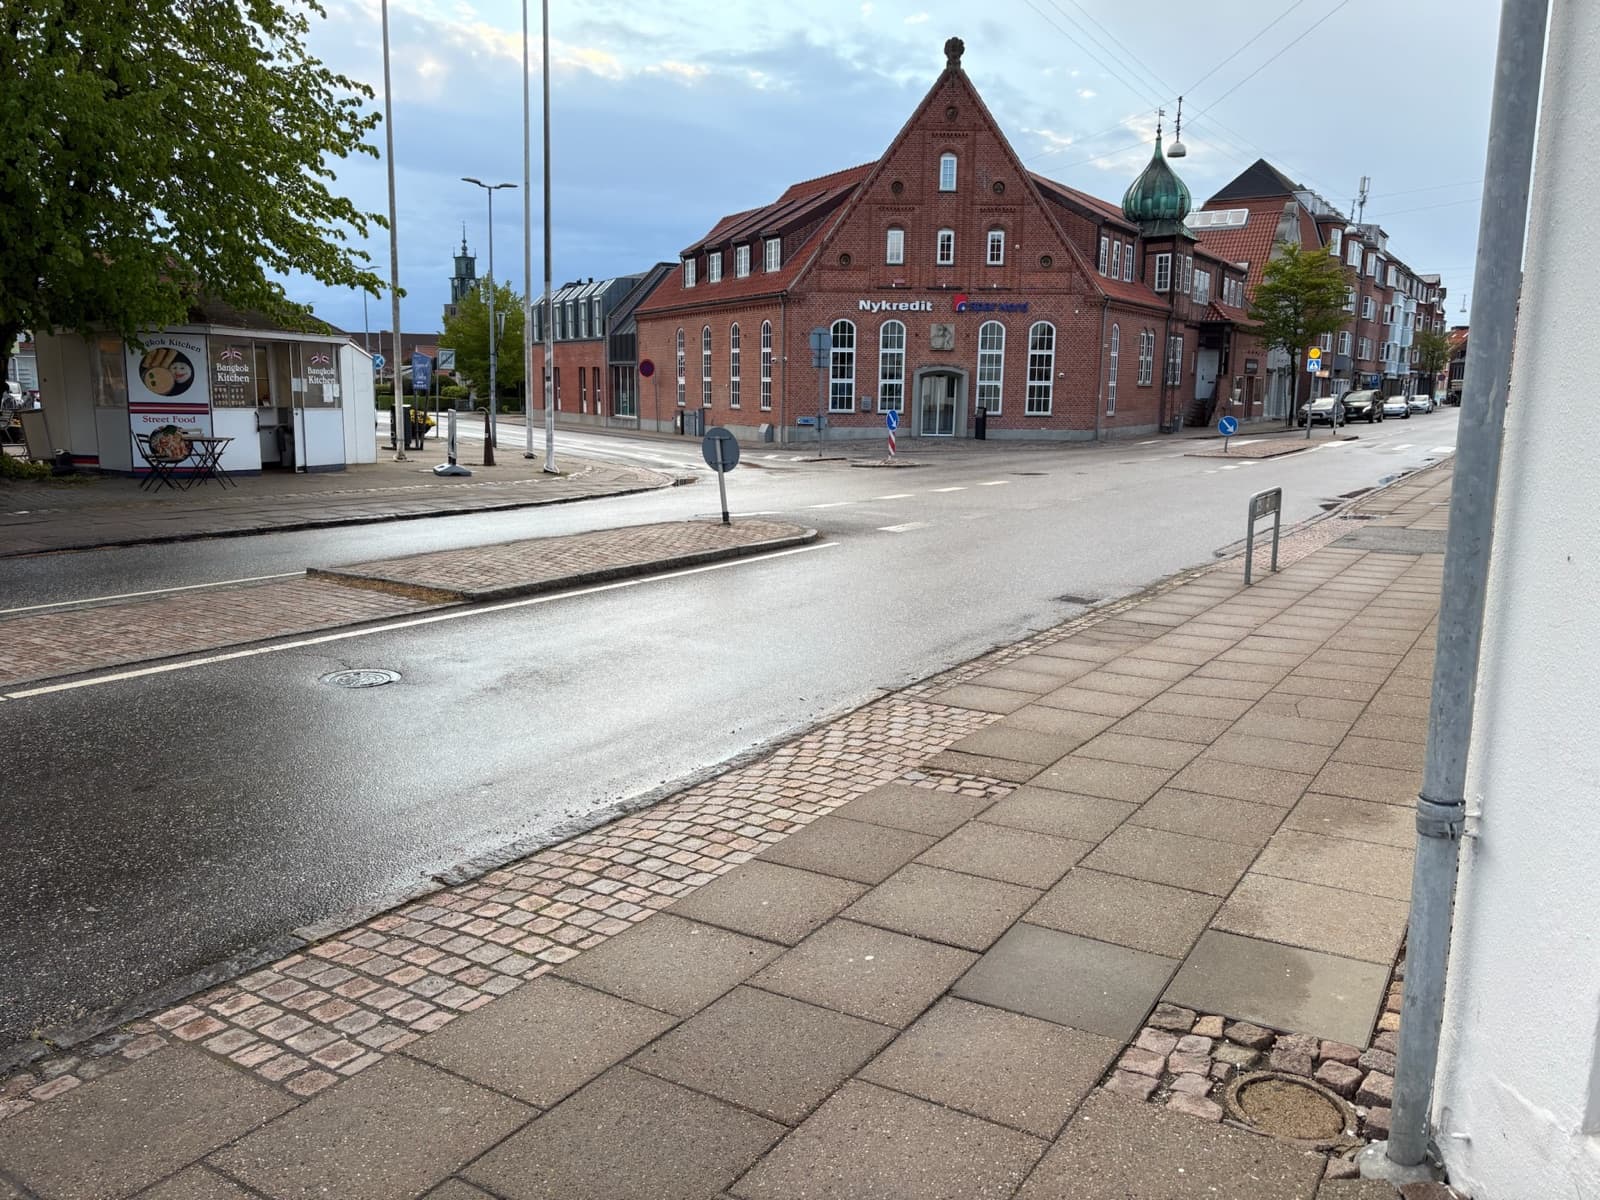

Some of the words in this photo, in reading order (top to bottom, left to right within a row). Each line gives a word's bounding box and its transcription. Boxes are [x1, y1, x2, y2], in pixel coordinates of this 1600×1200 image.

[859, 300, 933, 313] Nykredit
[168, 338, 201, 353] Kitchen
[216, 362, 249, 374] Bangkok
[307, 366, 336, 376] Bangkok
[217, 372, 250, 383] Kitchen
[308, 375, 336, 384] Kitchen
[142, 415, 170, 424] Street
[172, 415, 196, 424] Food
